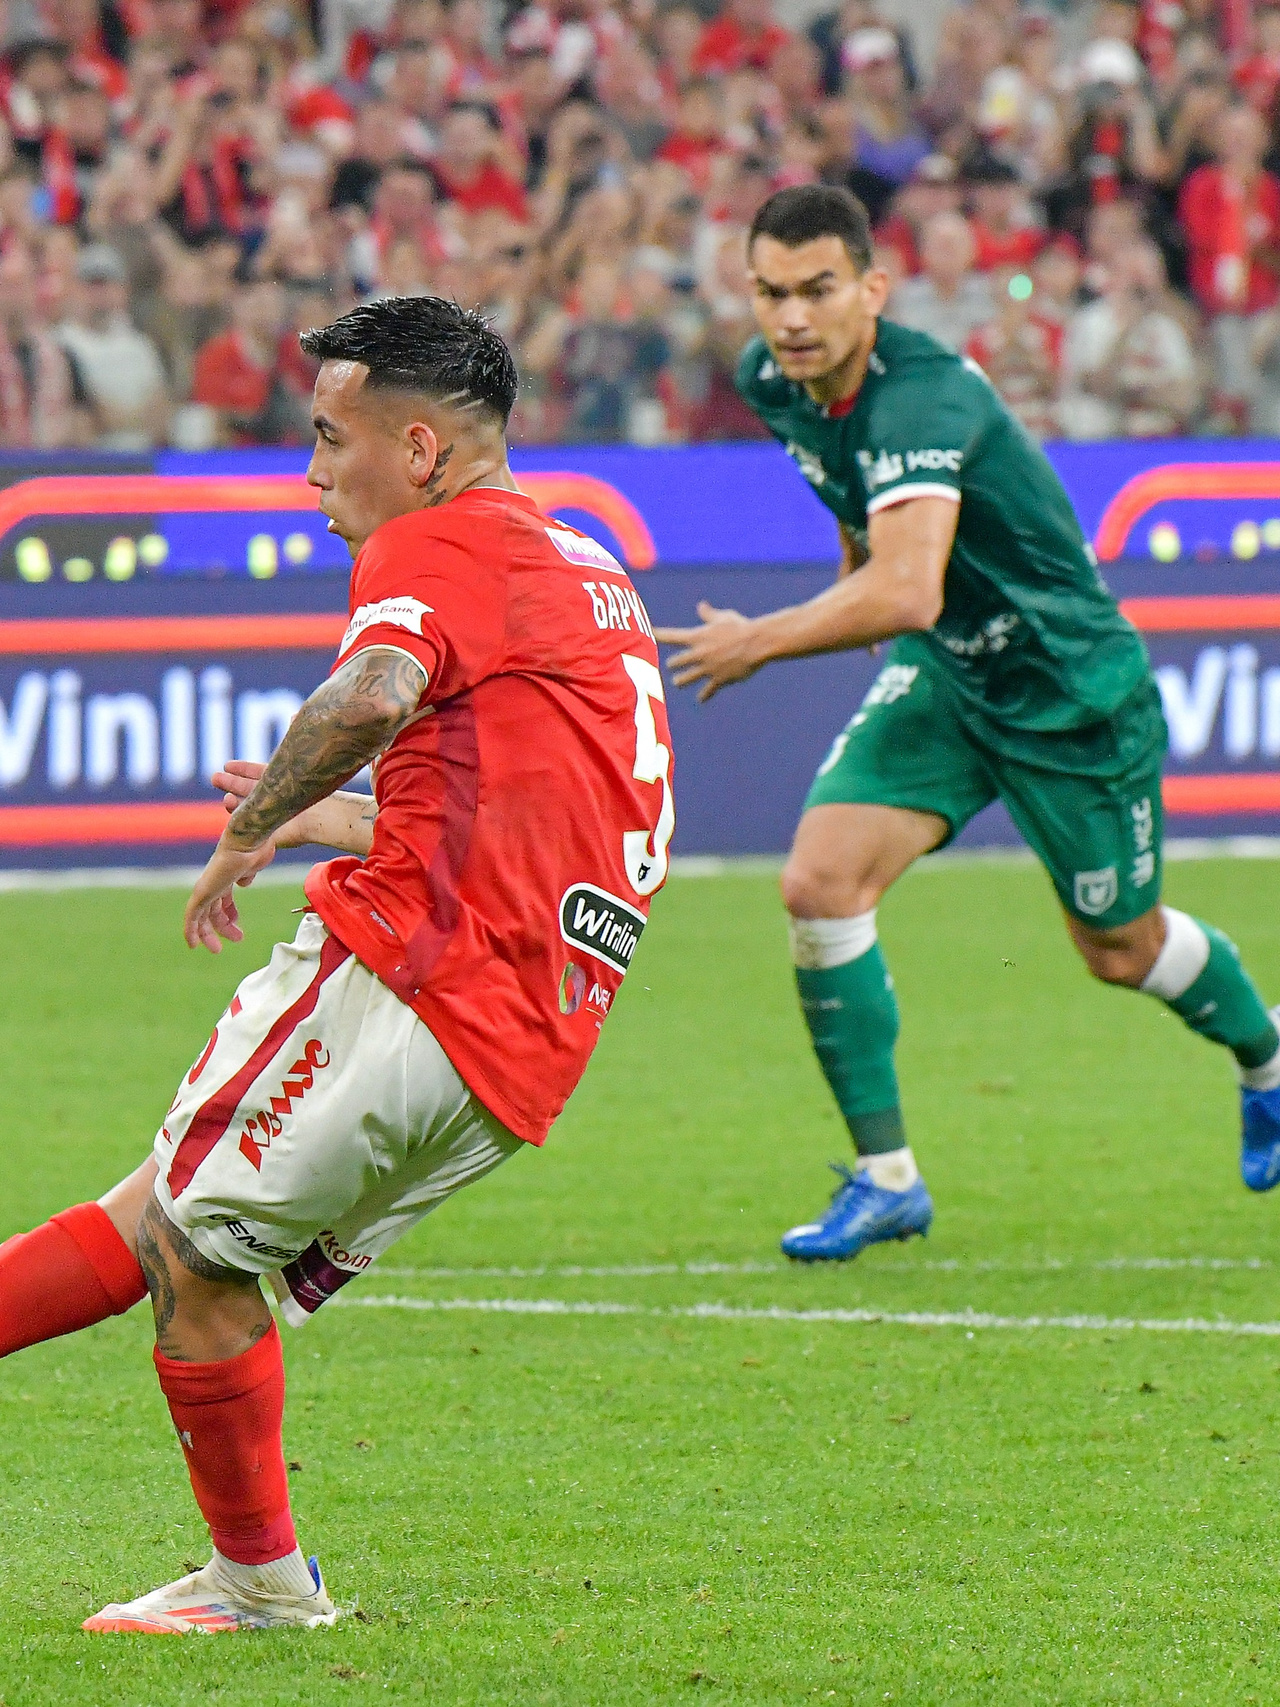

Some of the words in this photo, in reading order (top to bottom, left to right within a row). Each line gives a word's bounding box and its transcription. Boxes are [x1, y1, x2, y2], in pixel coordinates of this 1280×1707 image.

[380, 605, 415, 615] Банк
[581, 581, 657, 646] БАРК
[621, 652, 677, 897] 5
[573, 897, 638, 961] Winlin
